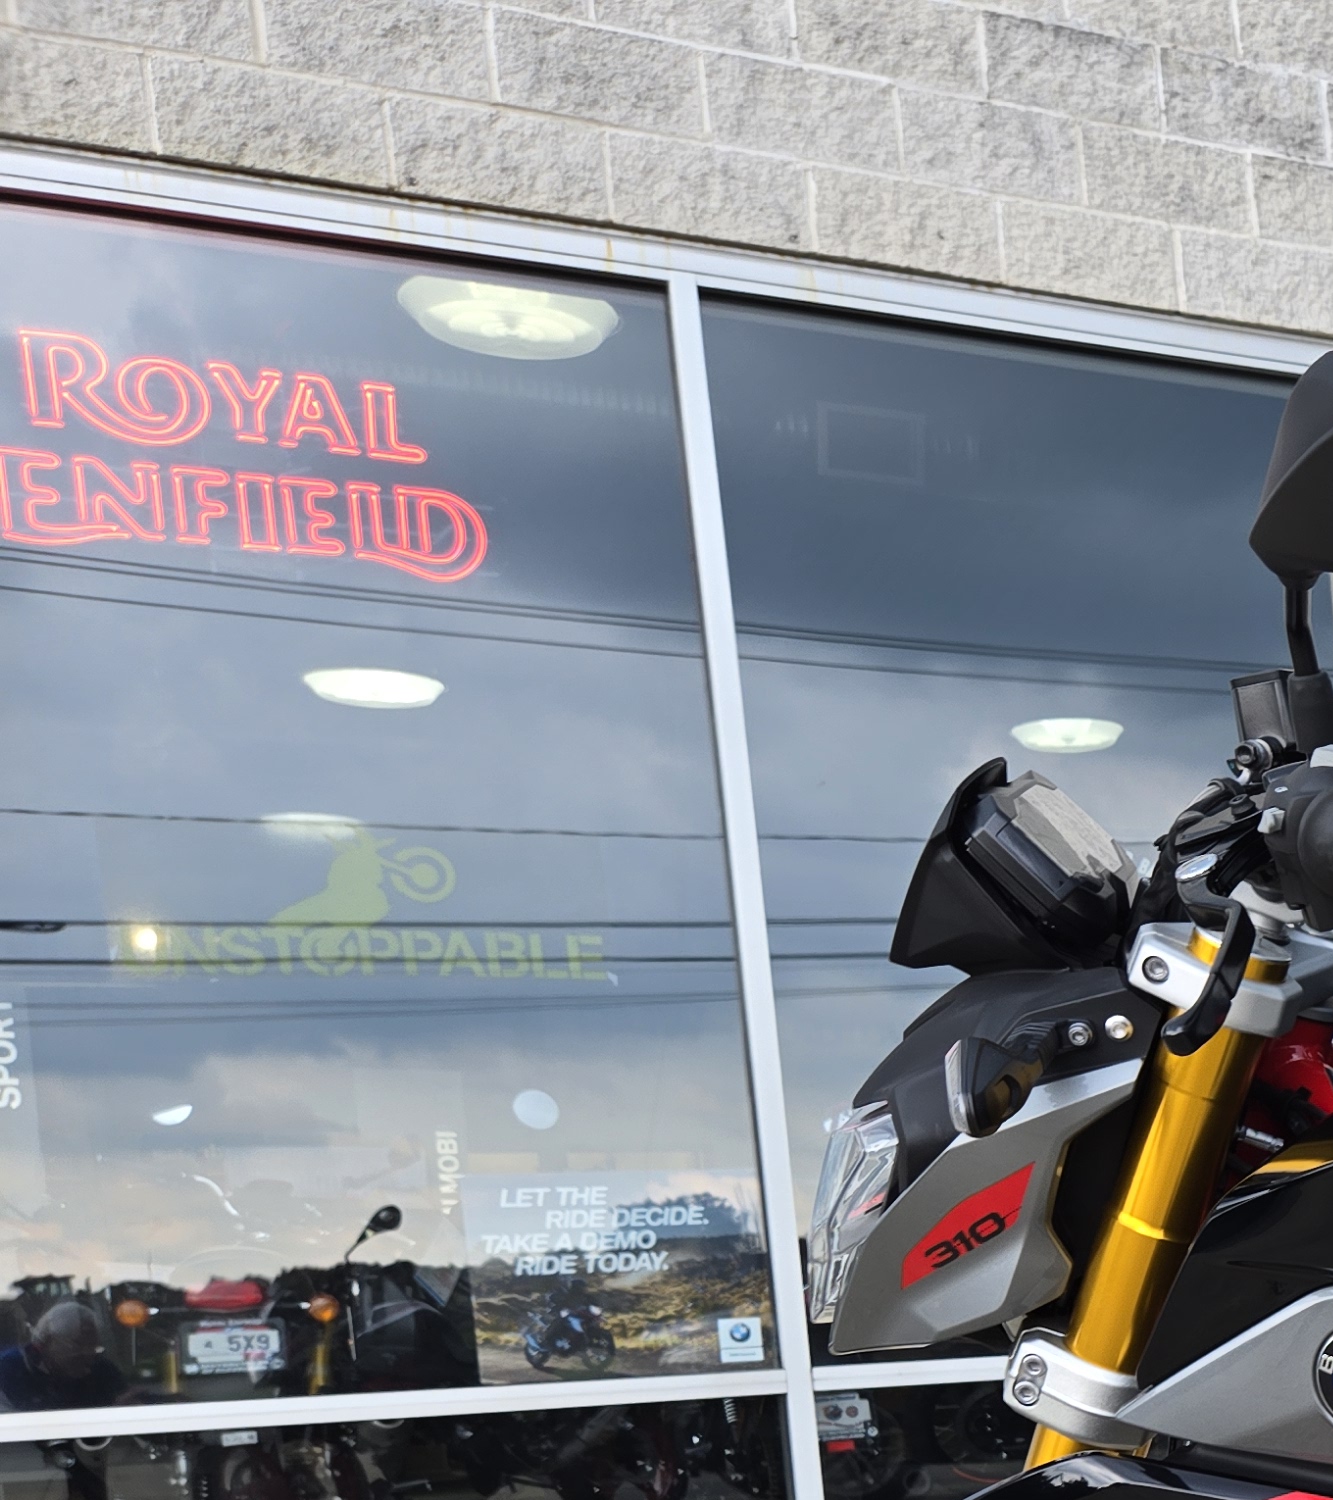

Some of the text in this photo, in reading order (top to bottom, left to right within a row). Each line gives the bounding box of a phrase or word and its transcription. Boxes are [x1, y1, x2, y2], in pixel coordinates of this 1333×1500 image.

[18, 328, 429, 465] ROYAL
[0, 444, 489, 583] ENFIELD
[113, 924, 608, 982] UNSTOPPABLE
[500, 1185, 608, 1208] LET THE
[545, 1205, 710, 1230] RIDE DECIDE.
[480, 1229, 657, 1255] TAKE A DEMO
[924, 1212, 1007, 1268] 310
[514, 1250, 669, 1277] RIDE TODAY.
